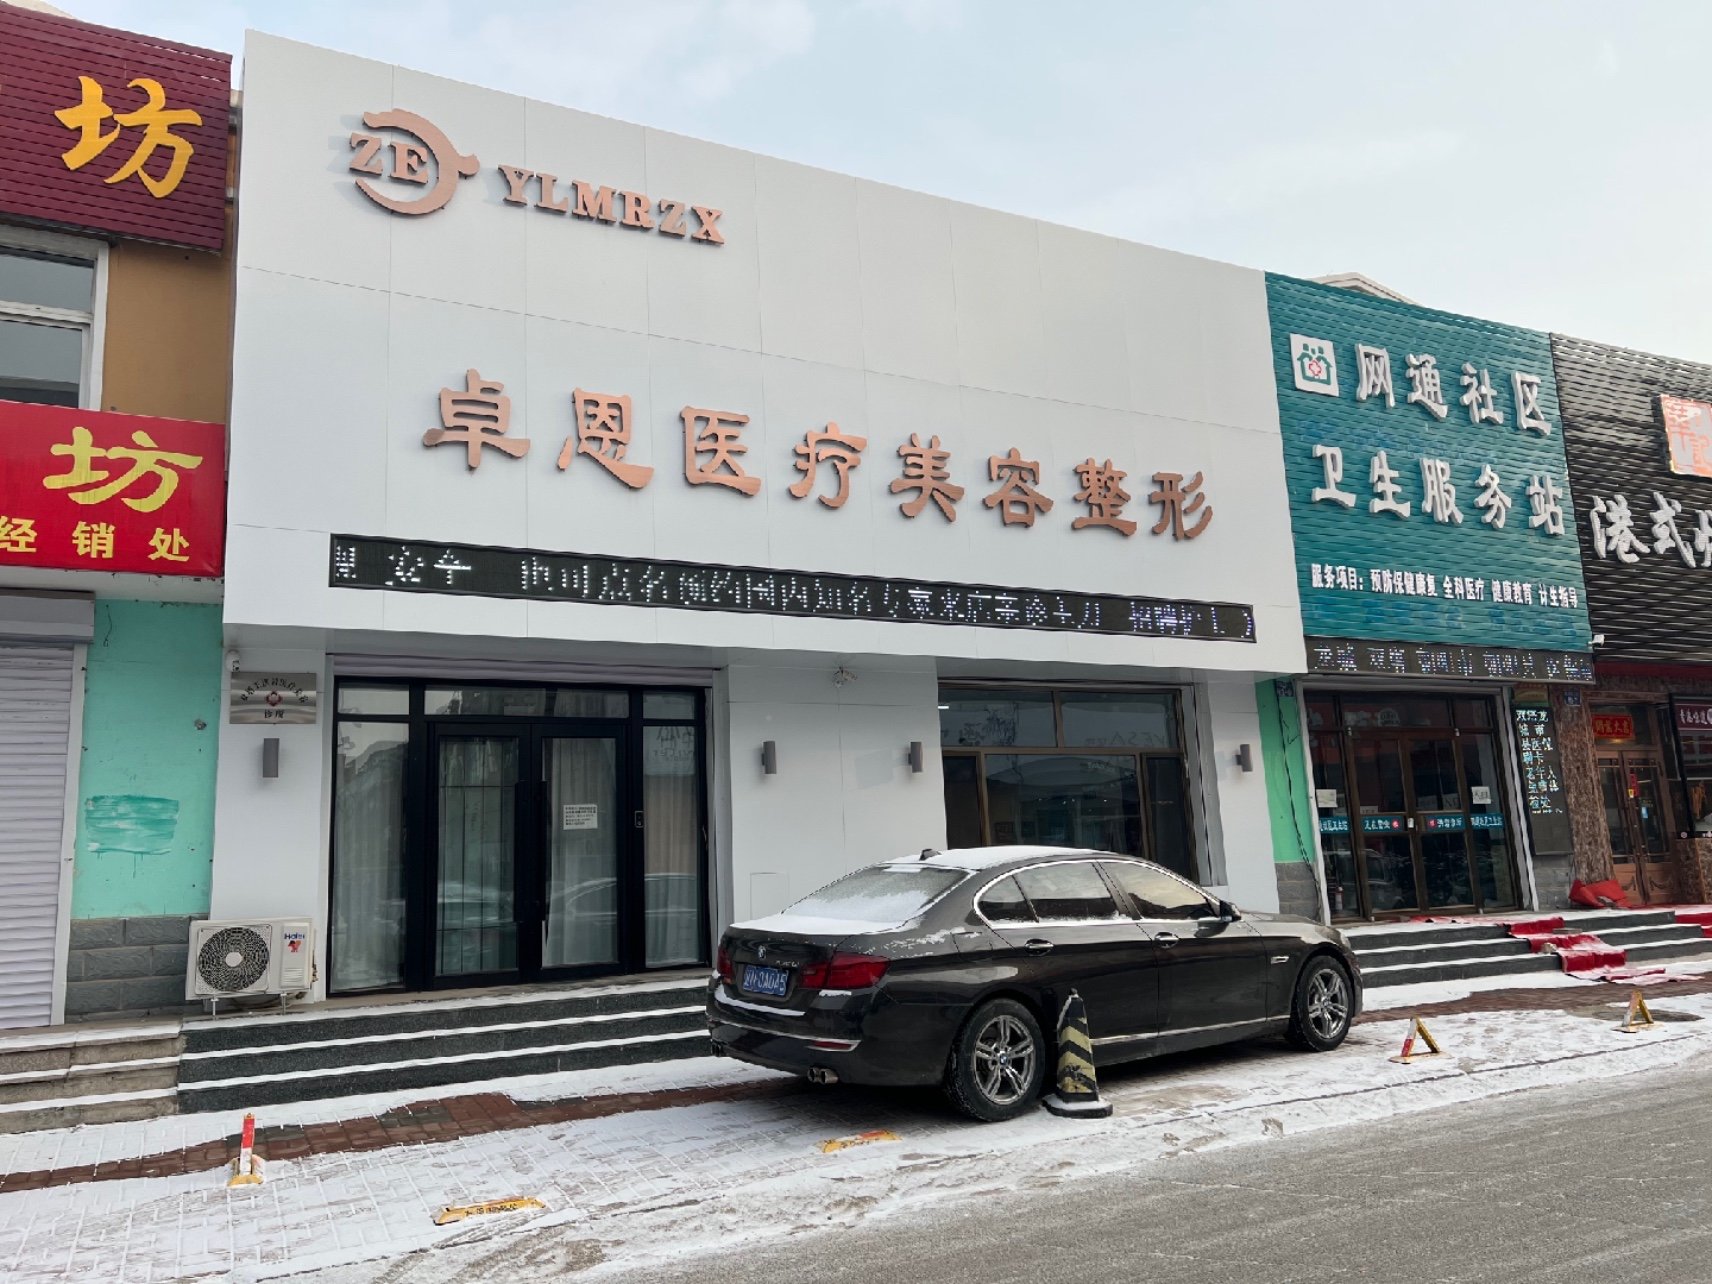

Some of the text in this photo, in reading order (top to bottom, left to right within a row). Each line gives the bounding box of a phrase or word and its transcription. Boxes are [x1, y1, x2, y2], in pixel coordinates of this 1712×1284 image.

[54, 75, 203, 198] 坊
[349, 132, 429, 184] ZE
[497, 164, 725, 245] YLMRZX
[1355, 343, 1551, 436] 网通社区
[42, 426, 203, 513] 坊
[422, 367, 1214, 541] 卓恩医疗美容整形
[1311, 444, 1566, 536] 卫生服务站
[0, 515, 190, 562] 经销处
[1442, 574, 1485, 601] 全科医疗
[1491, 578, 1533, 605] 健康教育
[1538, 583, 1578, 609] 计生指导
